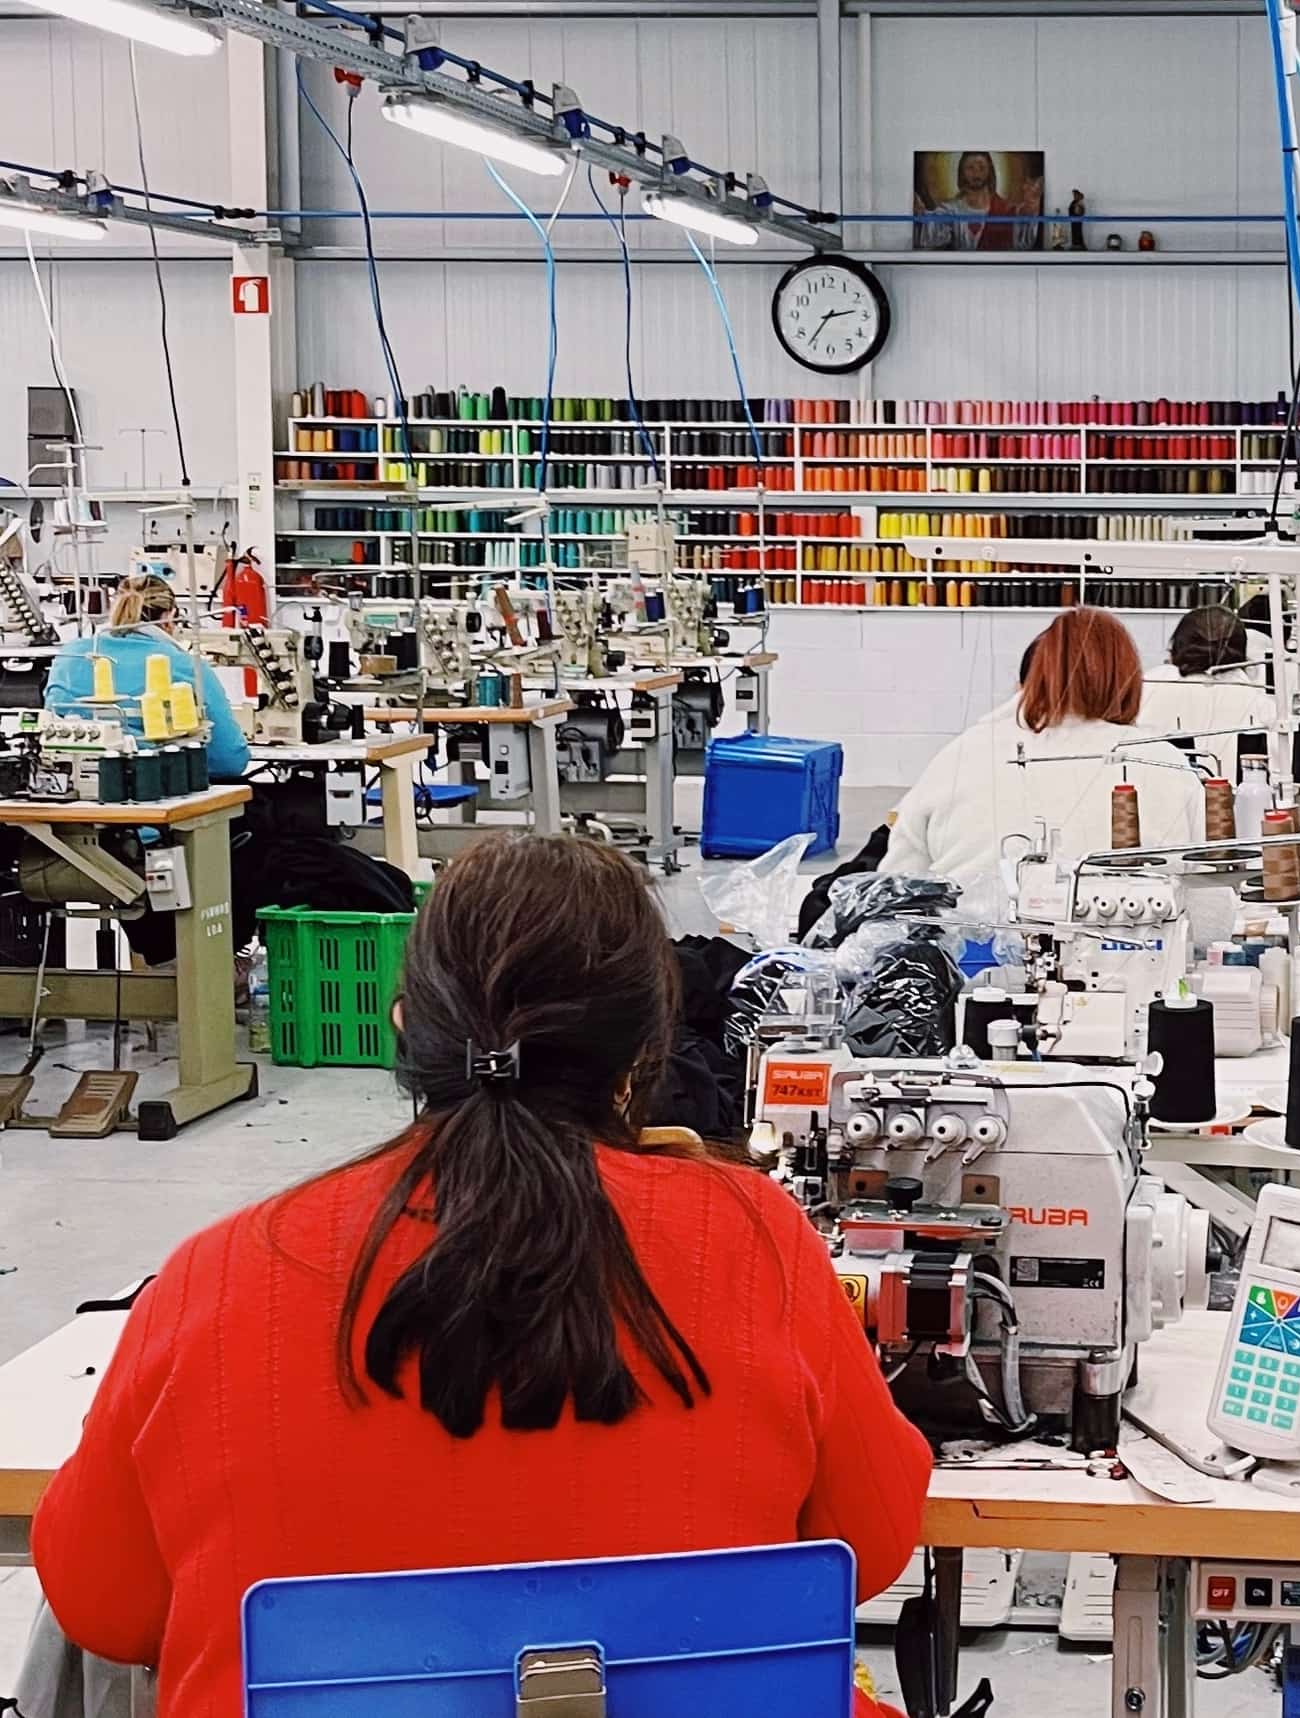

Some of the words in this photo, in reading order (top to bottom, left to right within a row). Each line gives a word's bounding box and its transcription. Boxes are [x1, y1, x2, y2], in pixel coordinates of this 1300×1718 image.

[807, 280, 818, 294] 11
[821, 275, 835, 289] 12
[796, 294, 810, 307] 10
[852, 291, 862, 304] 2
[790, 309, 800, 321] 9
[861, 310, 871, 321] 3
[796, 327, 807, 339] 8
[856, 327, 866, 339] 4
[845, 338, 853, 351] 5
[1212, 1588, 1229, 1598] OFF
